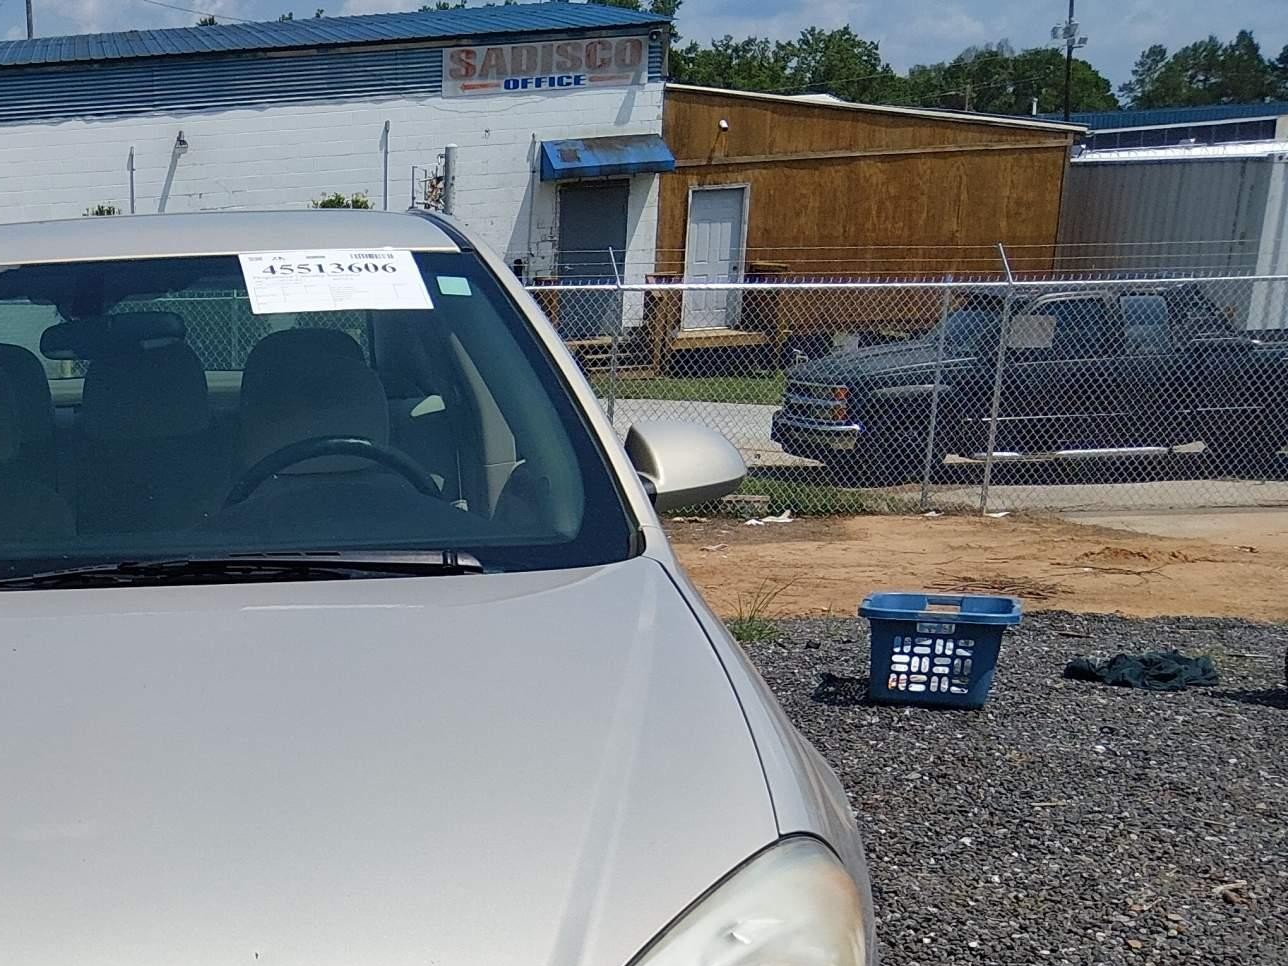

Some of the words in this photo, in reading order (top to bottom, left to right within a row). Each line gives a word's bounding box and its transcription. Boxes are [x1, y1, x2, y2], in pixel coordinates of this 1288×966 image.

[449, 38, 643, 80] SADISCO
[503, 74, 587, 91] OFFICE
[261, 262, 398, 276] 45513606
